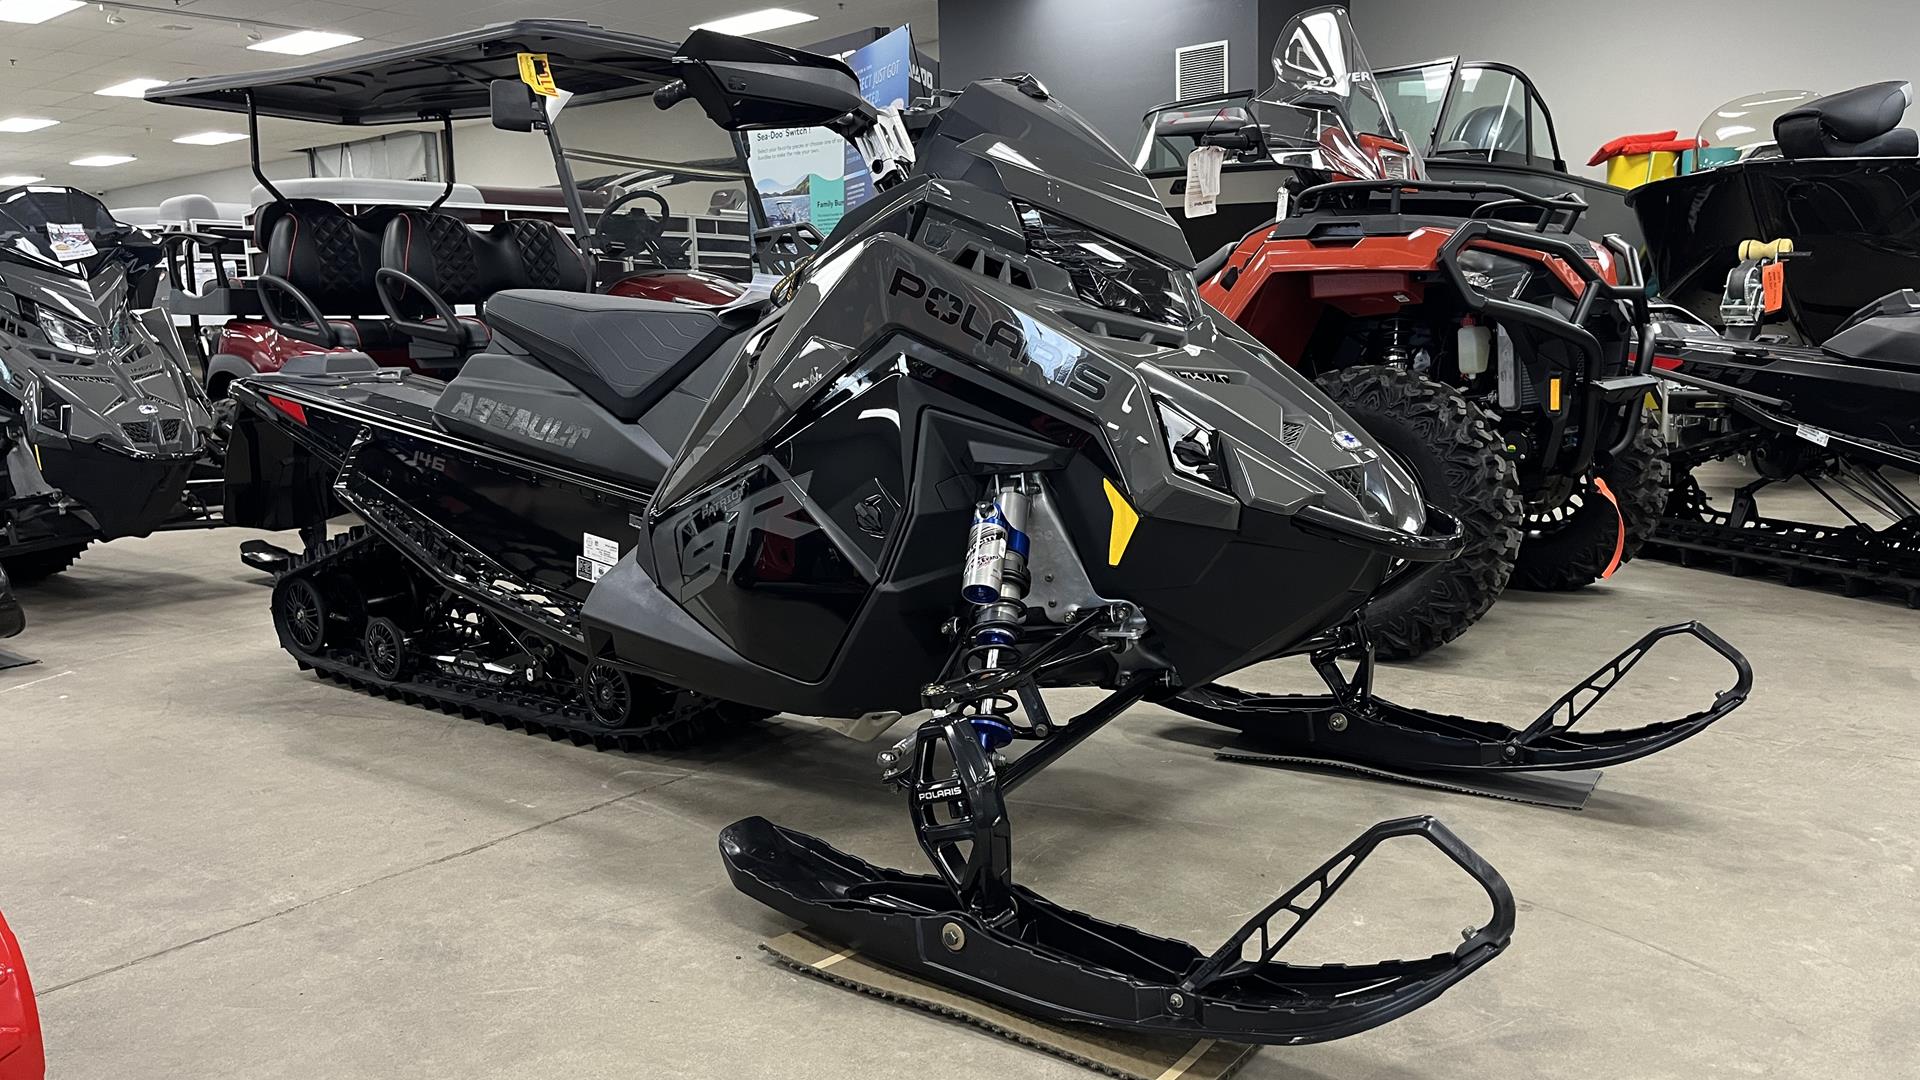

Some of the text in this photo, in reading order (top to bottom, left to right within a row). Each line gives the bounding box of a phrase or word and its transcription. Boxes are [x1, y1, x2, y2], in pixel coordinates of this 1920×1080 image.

[888, 267, 1112, 401] POLARIS
[451, 391, 592, 449] ASSAULT
[701, 479, 750, 520] PATRIOT
[918, 786, 962, 800] POLARIS
